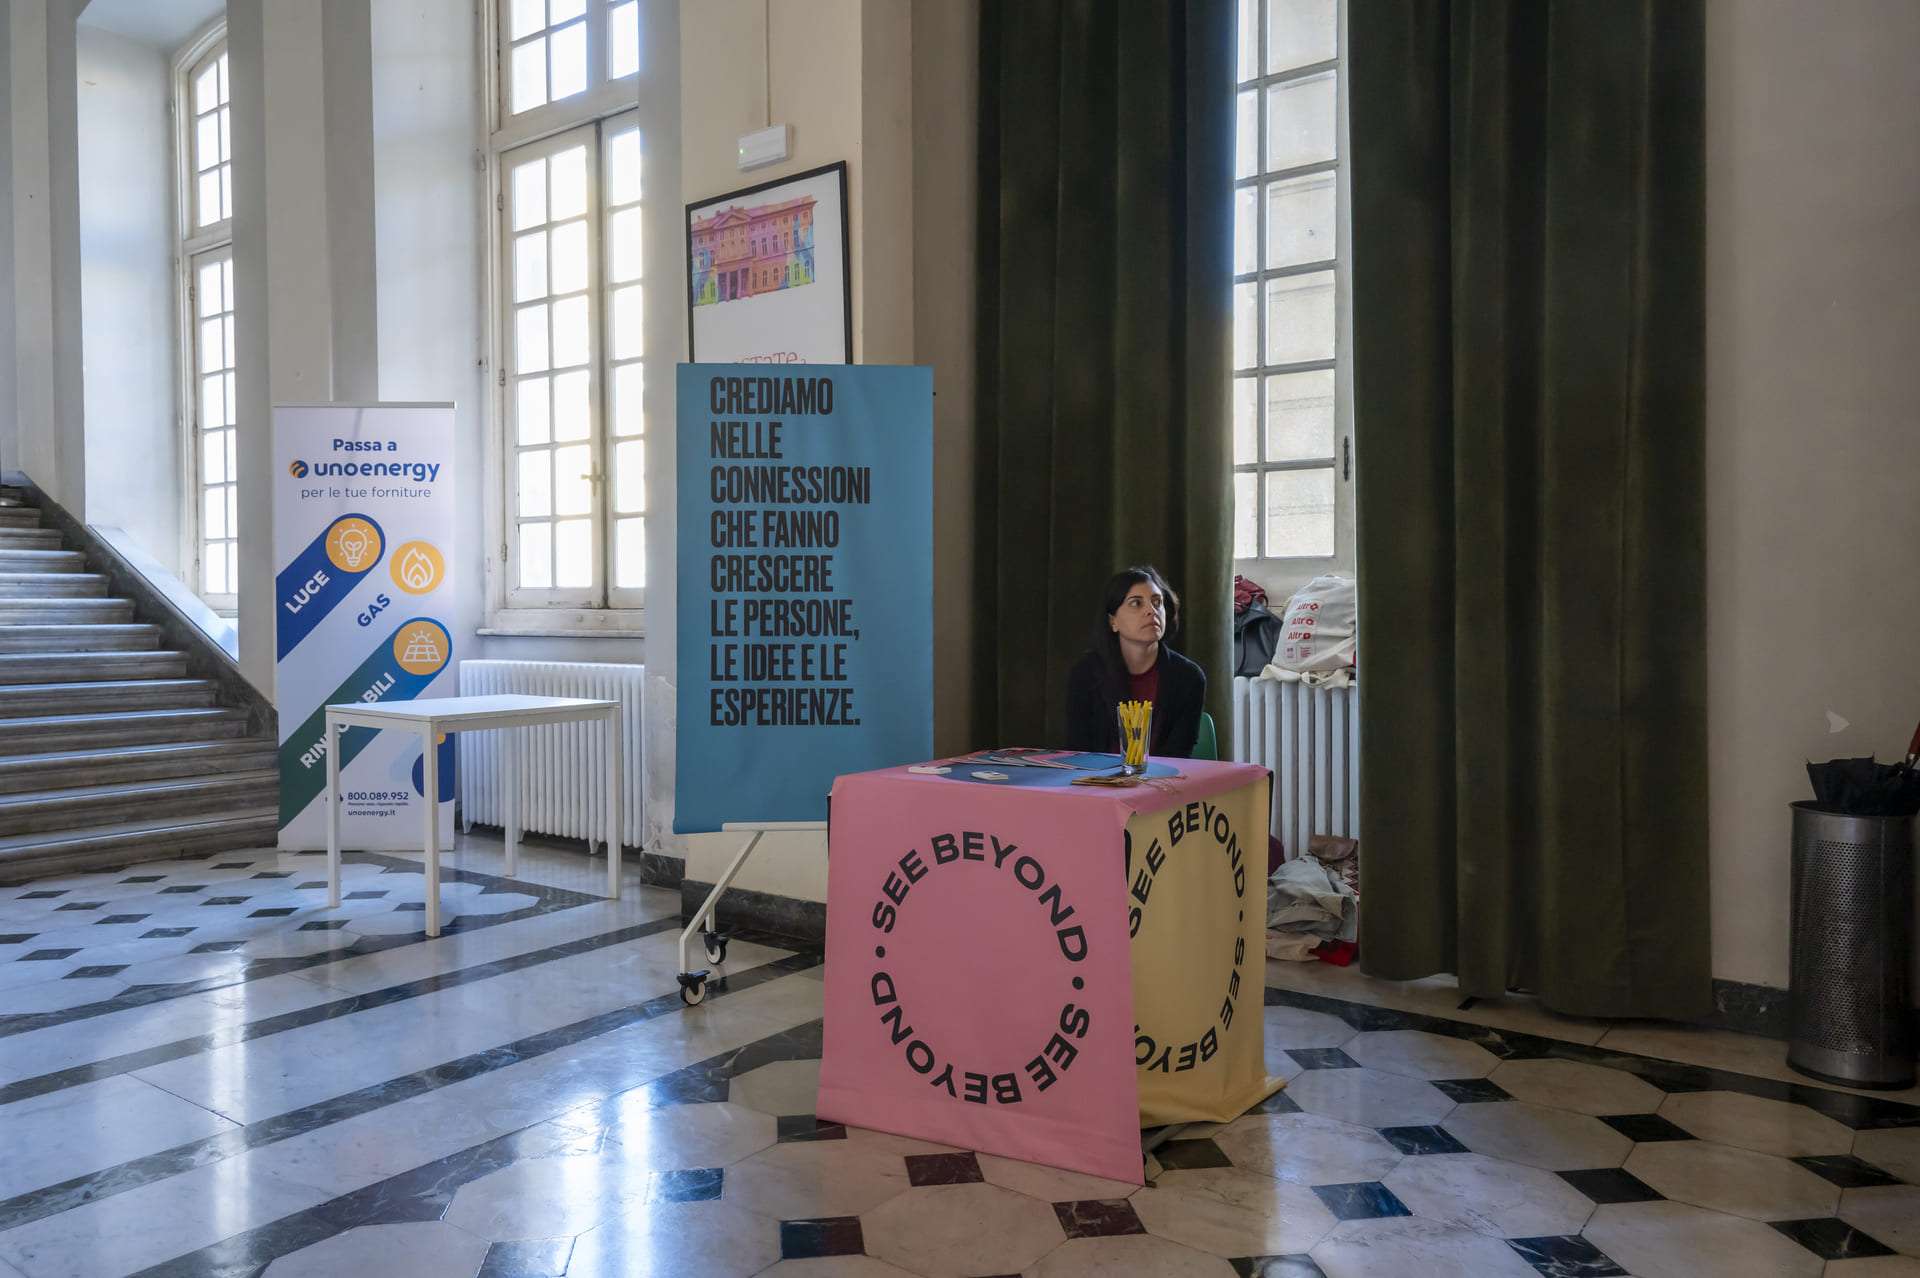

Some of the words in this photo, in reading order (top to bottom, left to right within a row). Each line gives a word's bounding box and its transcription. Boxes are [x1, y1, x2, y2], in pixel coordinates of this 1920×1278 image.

[710, 376, 833, 415] CREDIAMO
[333, 438, 382, 451] Passa
[387, 441, 397, 451] a
[710, 421, 783, 459] NELLE
[314, 462, 440, 482] unoenergy
[710, 466, 870, 504] CONNESSIONI
[301, 488, 324, 499] per
[328, 487, 340, 498] le
[344, 488, 367, 498] tue
[371, 487, 432, 498] forniture
[710, 510, 758, 548] CHE
[762, 510, 839, 548] FANNO
[285, 570, 330, 615] LUCE
[710, 555, 833, 592] CRESCERE
[357, 594, 391, 627] GAS
[711, 600, 738, 637] LE
[743, 600, 860, 640] PERSONE,
[711, 644, 738, 681] LE
[743, 644, 796, 681] IDEE
[801, 644, 815, 681] E
[820, 644, 847, 681] LE
[710, 688, 860, 726] ESPERIENZE.
[347, 791, 409, 801] 800.089.952
[1168, 801, 1245, 898] BEYOND
[872, 849, 929, 933] SEE
[931, 831, 1088, 962] BEYOND
[1220, 936, 1245, 1031] SEE
[871, 971, 1022, 1105] BEYOND
[1024, 1003, 1090, 1092] SEE
